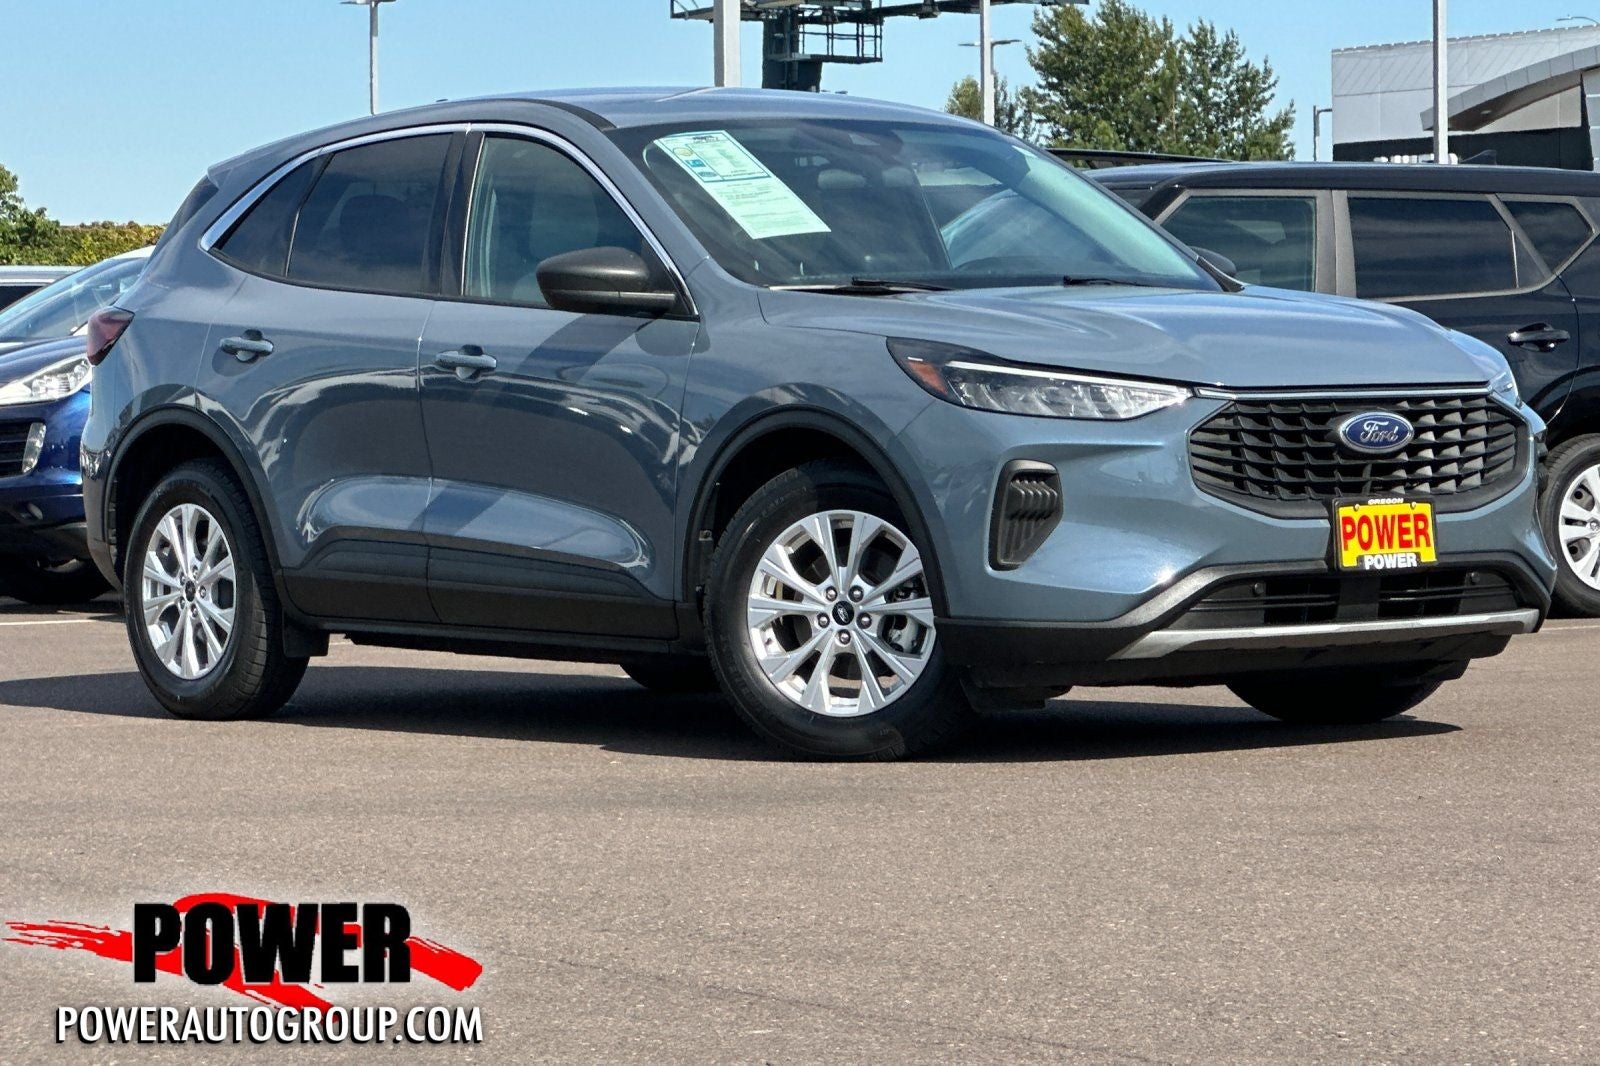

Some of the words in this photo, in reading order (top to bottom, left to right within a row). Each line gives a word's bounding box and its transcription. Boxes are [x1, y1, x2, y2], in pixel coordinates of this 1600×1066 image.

[1360, 420, 1399, 443] Ford
[1341, 513, 1431, 551] POWER
[1363, 553, 1418, 570] POWER
